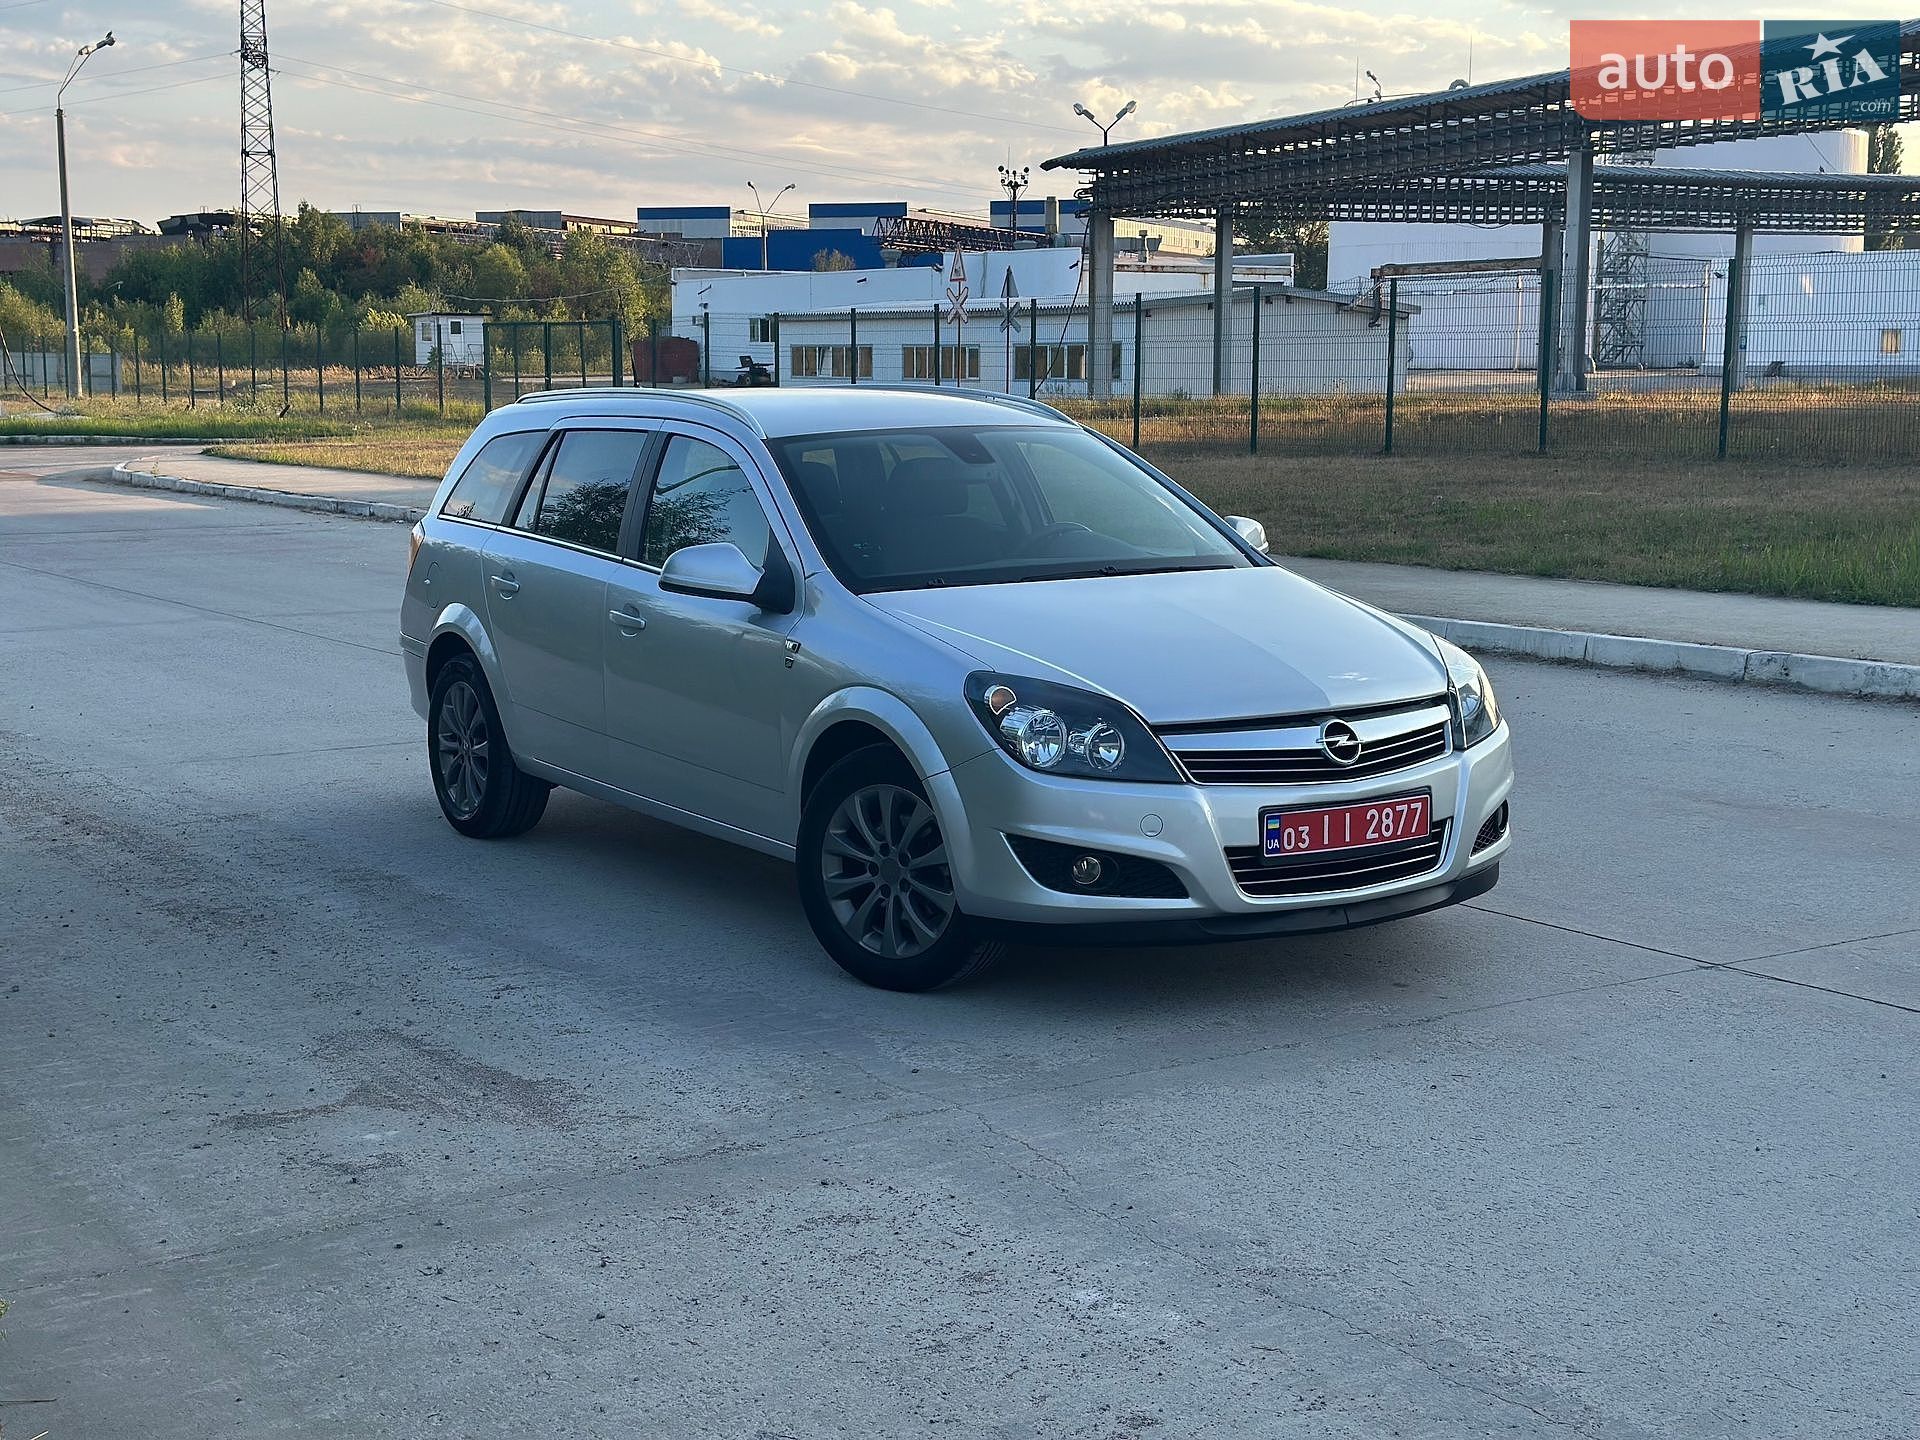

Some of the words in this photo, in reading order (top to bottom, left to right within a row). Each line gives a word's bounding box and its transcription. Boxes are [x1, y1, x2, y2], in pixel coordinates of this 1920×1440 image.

[1283, 826, 1310, 851] 03
[1366, 802, 1422, 840] 2877
[1267, 839, 1280, 850] UA
